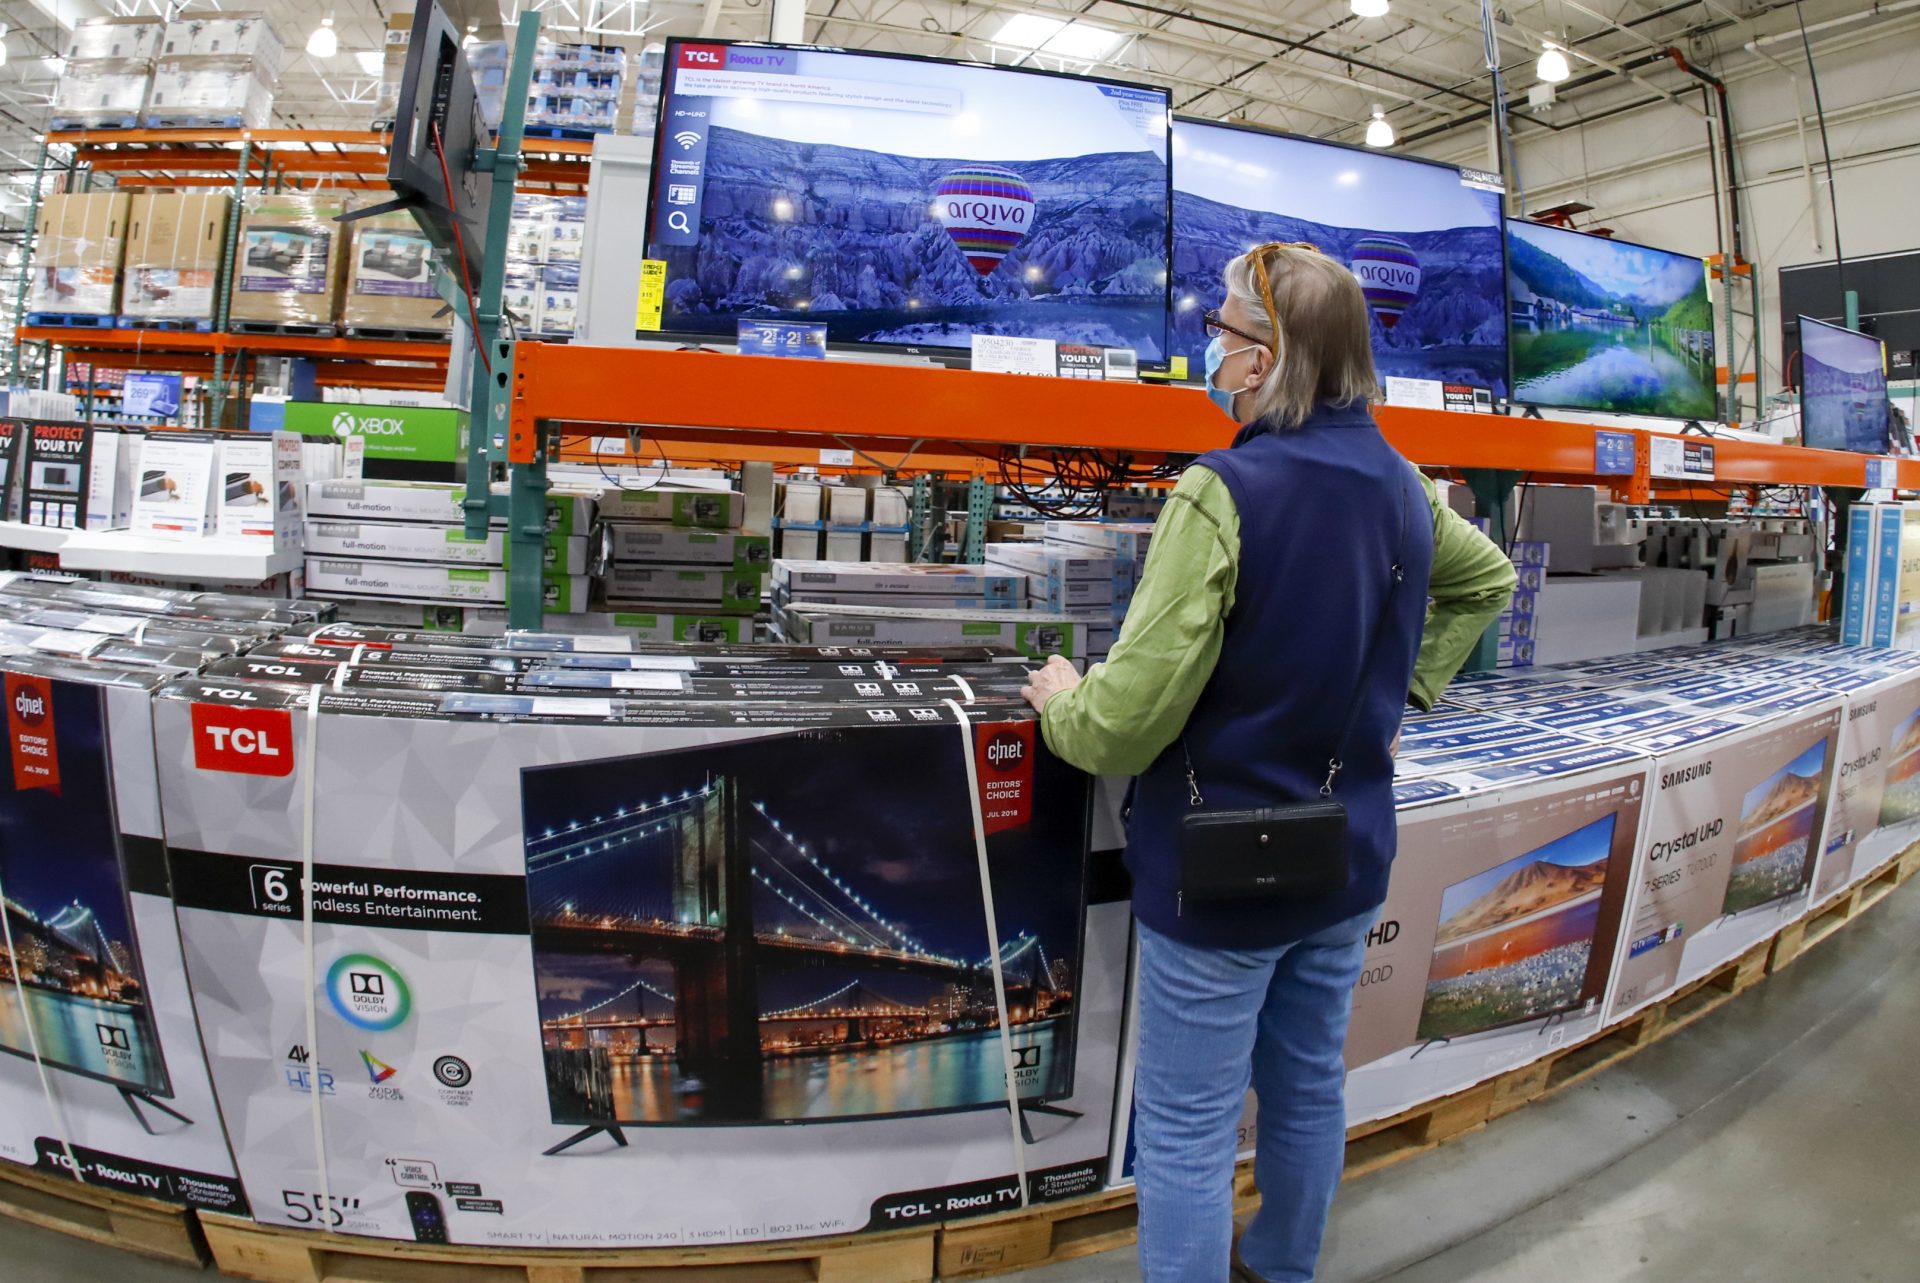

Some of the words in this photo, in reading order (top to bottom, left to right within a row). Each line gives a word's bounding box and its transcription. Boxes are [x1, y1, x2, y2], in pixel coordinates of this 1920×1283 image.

[684, 51, 719, 63] TCL
[730, 53, 763, 65] Roku
[766, 56, 785, 66] TV
[948, 202, 1025, 226] arqiva
[1361, 264, 1415, 286] arqiva
[1060, 355, 1088, 364] YOUR
[1089, 356, 1101, 364] TV
[34, 425, 84, 439] PROTECT
[358, 417, 404, 435] XBOX
[34, 439, 65, 452] YOUR
[67, 441, 84, 452] TV
[347, 503, 391, 512] full-motion
[342, 541, 386, 550] full-motion
[345, 578, 388, 588] full-motion
[323, 628, 365, 638] TCL
[248, 665, 302, 676] TCL
[362, 670, 402, 678] Powerful
[404, 672, 465, 680] Performance.
[201, 687, 258, 701] TCL
[370, 698, 437, 708] Performance.
[206, 726, 279, 756] TCL
[21, 744, 48, 756] CHOICE
[1661, 761, 1712, 790] SAMSUNG
[987, 780, 1022, 789] EDITORS'
[987, 790, 1020, 800] CHOICE
[1650, 826, 1698, 862] Crystal
[1700, 819, 1723, 842] UHD
[264, 870, 288, 902] 6
[299, 878, 368, 896] owerful
[373, 884, 482, 902] Performance.
[1651, 868, 1682, 892] SERIES
[262, 902, 292, 912] series
[303, 897, 360, 914] ndless
[365, 902, 482, 921] Entertainment.
[1365, 920, 1400, 947] HD
[1360, 965, 1393, 987] 00D
[354, 994, 384, 1004] DOLBY
[355, 1004, 388, 1013] VISION
[101, 1047, 132, 1060] DOLBY
[96, 1164, 137, 1183] Roku
[138, 1175, 161, 1188] TV
[401, 1172, 428, 1181] CONTROL
[1043, 1168, 1093, 1182] Thousands
[179, 1177, 229, 1192] Thousands
[1039, 1183, 1048, 1191] of
[1051, 1174, 1096, 1190] Streaming
[190, 1186, 236, 1201] Streaming
[885, 1204, 931, 1219] TCL
[947, 1195, 991, 1210] Roku
[995, 1187, 1020, 1200] TV
[486, 1232, 523, 1240] SMART
[553, 1233, 604, 1241] NATURAL
[609, 1232, 653, 1240] MOTION
[657, 1232, 677, 1240] 240
[698, 1230, 725, 1238] HDMI
[736, 1228, 759, 1236] LED
